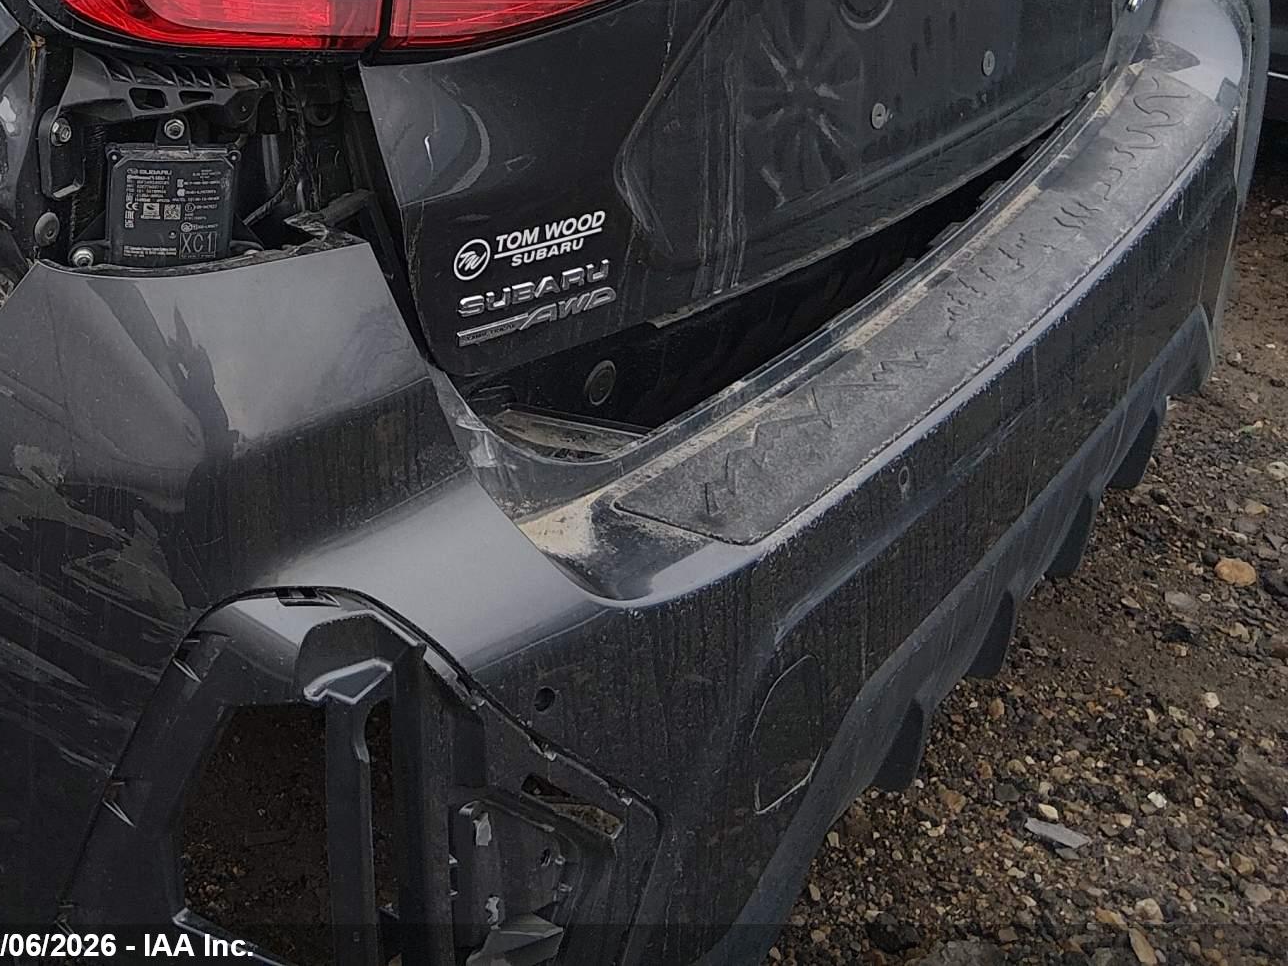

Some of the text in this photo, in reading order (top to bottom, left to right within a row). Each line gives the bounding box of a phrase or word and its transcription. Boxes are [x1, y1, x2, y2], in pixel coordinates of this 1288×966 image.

[182, 232, 212, 253] XC1
[496, 211, 605, 252] TOM WOOD
[511, 238, 584, 266] SUBARU
[457, 259, 609, 317] SUBARU
[519, 286, 616, 331] AWD
